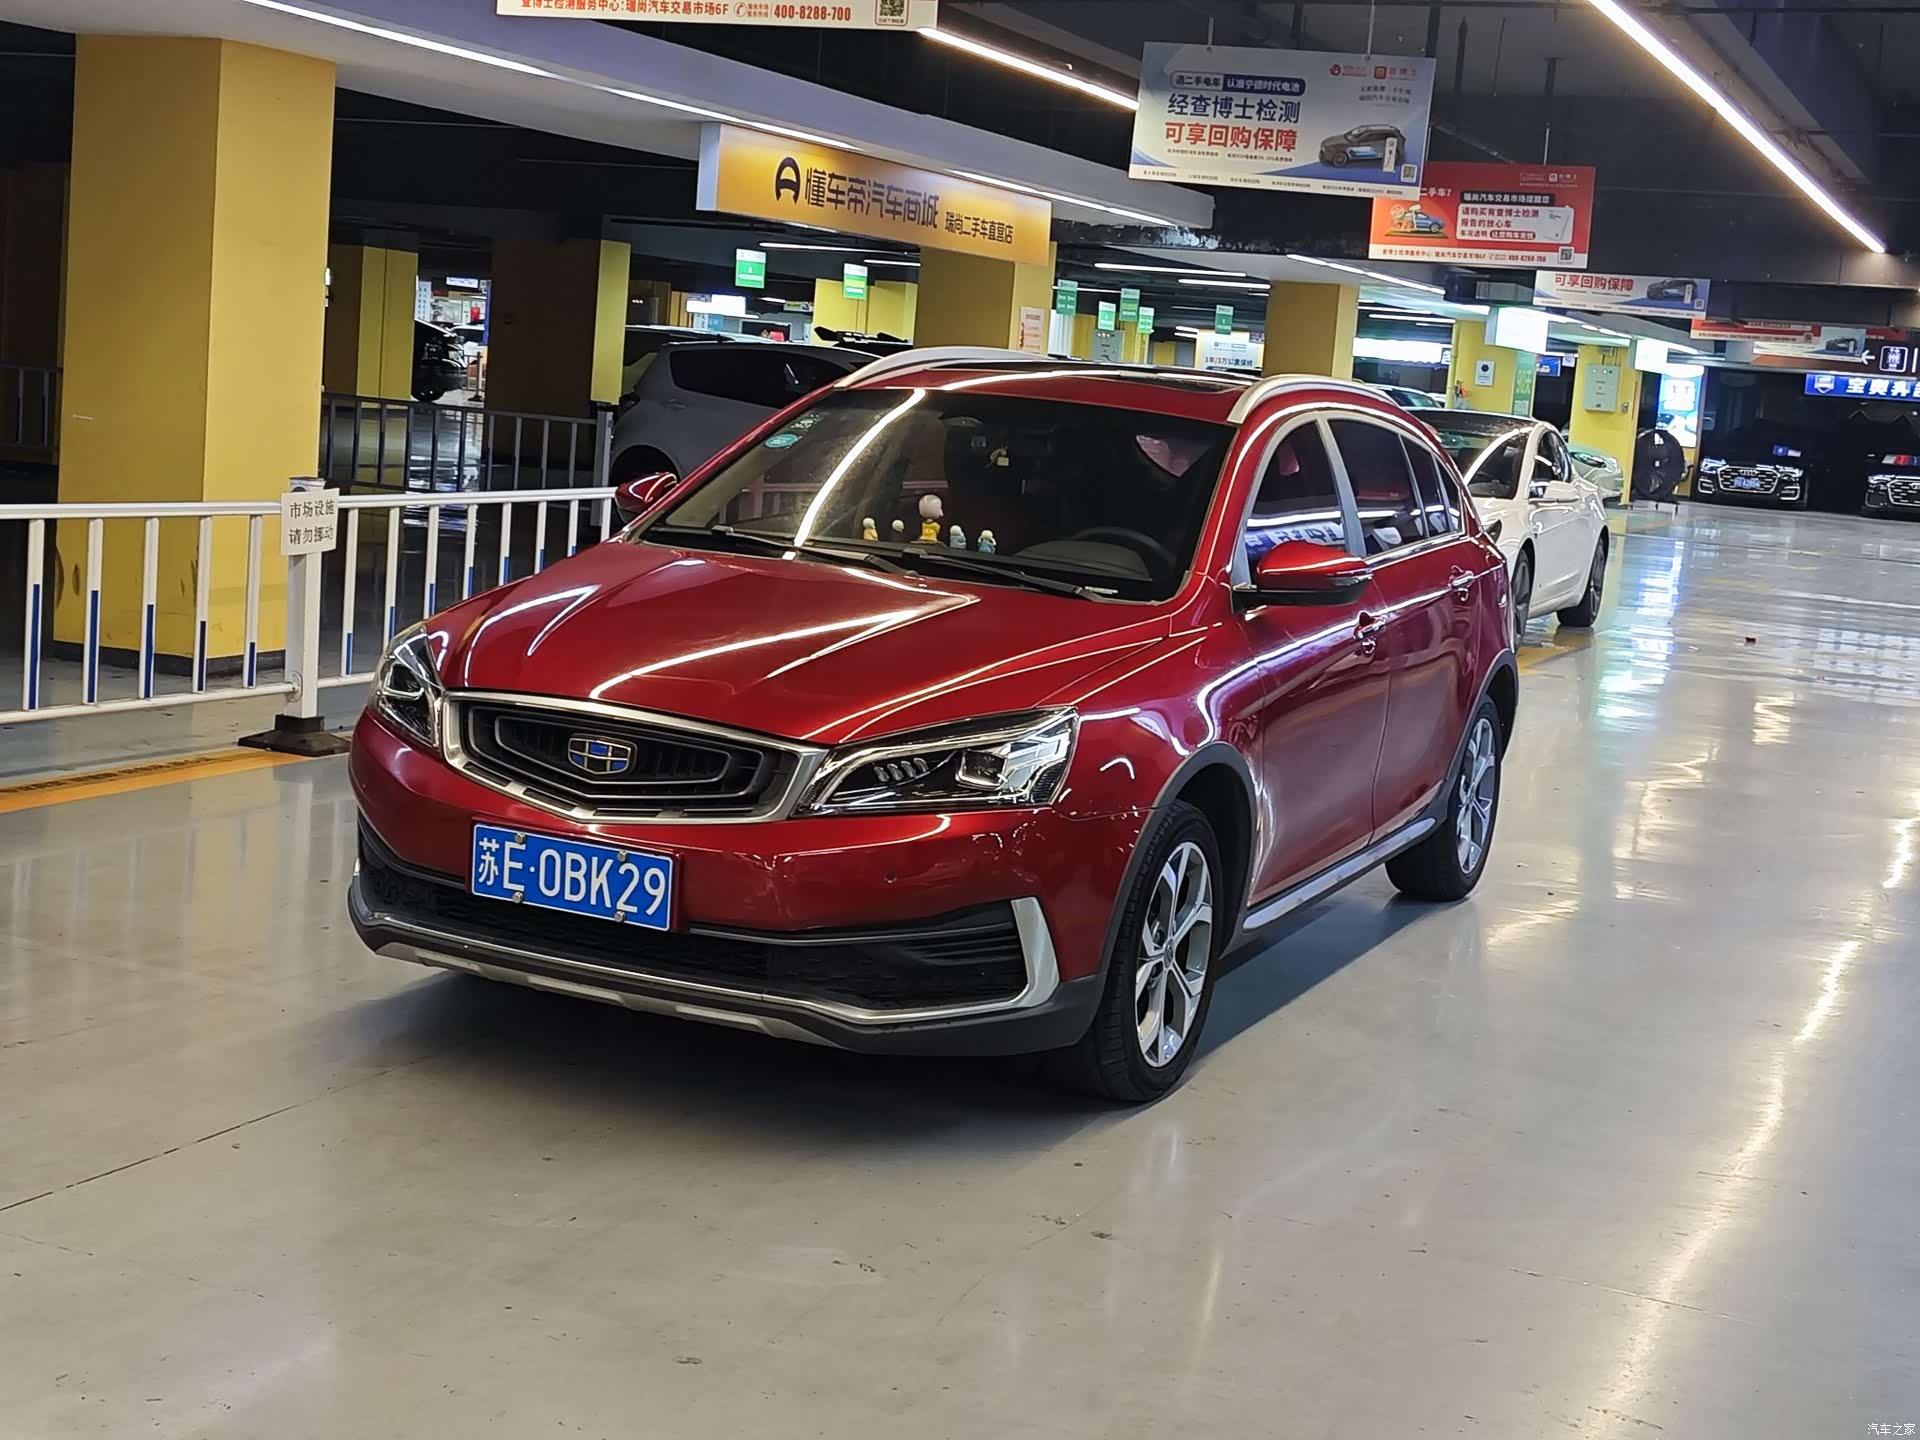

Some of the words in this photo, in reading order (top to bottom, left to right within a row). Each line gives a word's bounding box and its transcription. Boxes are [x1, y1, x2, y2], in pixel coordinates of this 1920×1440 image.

[774, 4, 851, 21] 400-8288-700
[1168, 94, 1302, 124] 经查博士检测
[1165, 122, 1299, 153] 可享回购保障
[805, 167, 941, 229] 懂车帝汽车商城
[945, 211, 1014, 245] 瑞尚二手车直营店
[1554, 273, 1634, 292] 可享回购保障
[289, 500, 335, 519] 市场设施
[289, 525, 334, 545] 请勿挪动
[478, 837, 666, 916] 苏E·0BK29
